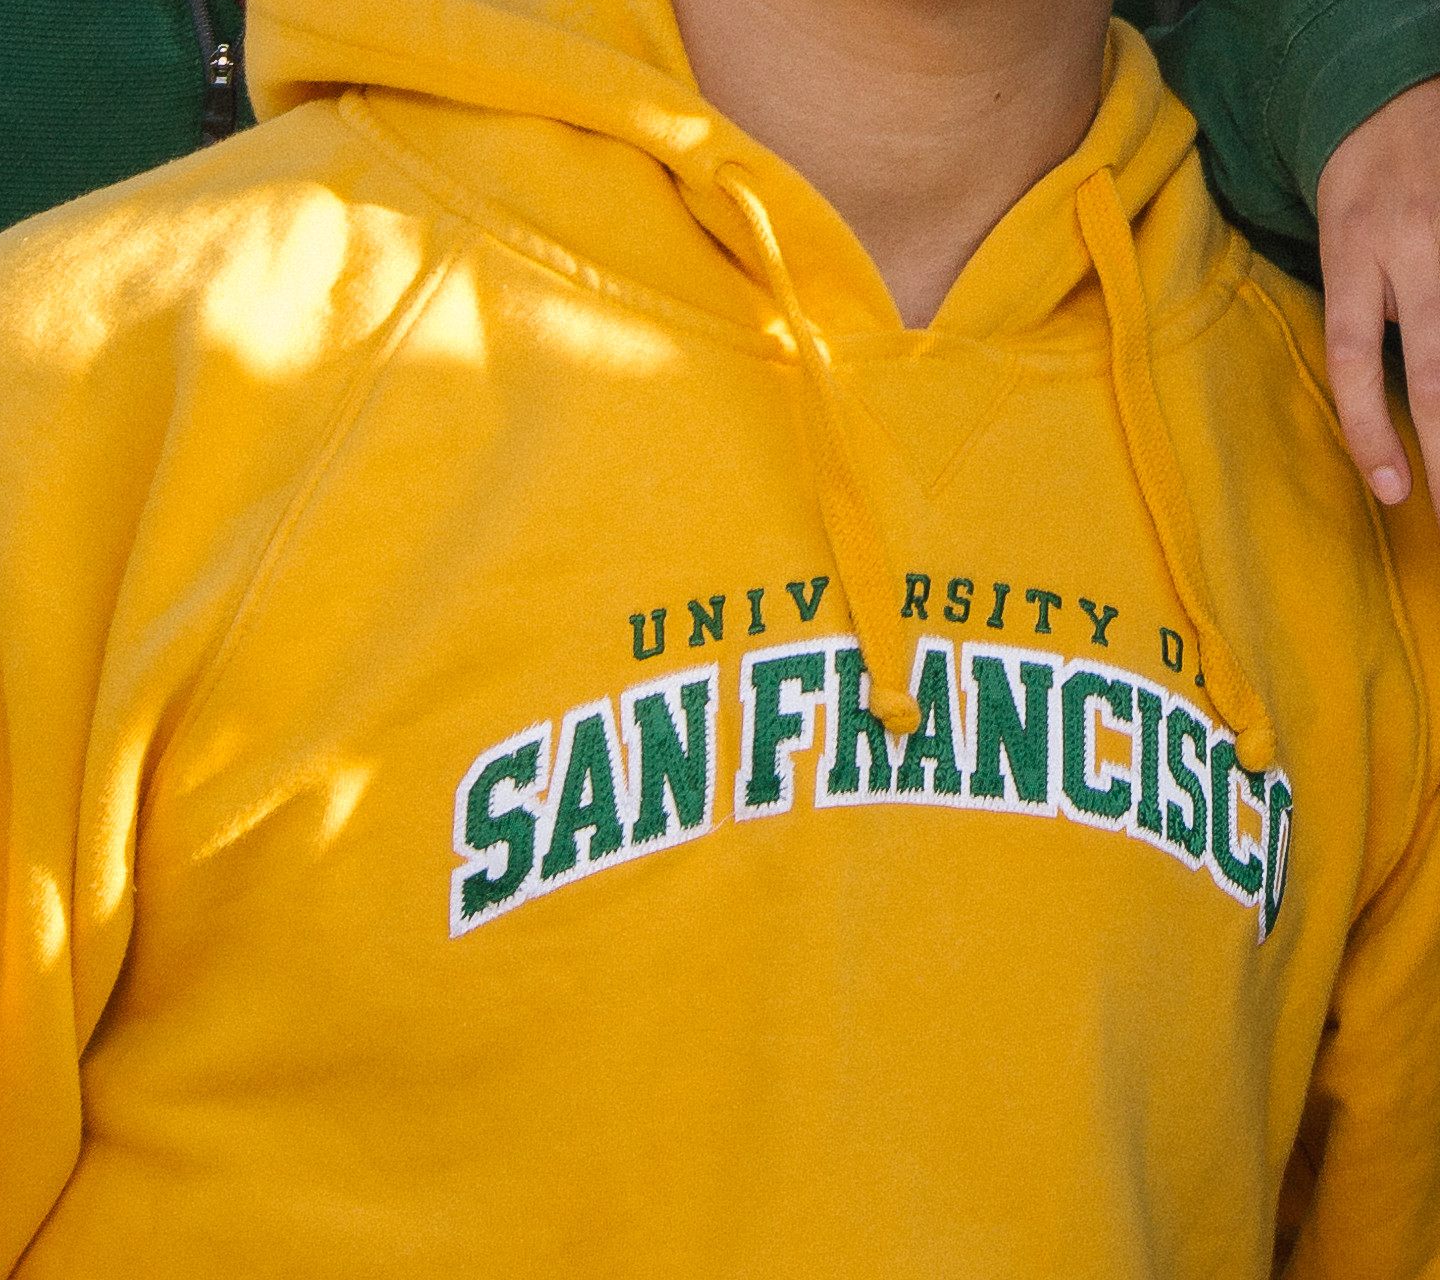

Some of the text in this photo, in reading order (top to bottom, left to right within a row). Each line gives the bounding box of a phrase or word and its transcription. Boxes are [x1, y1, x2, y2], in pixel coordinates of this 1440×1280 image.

[629, 572, 1206, 688] UNIVRSITY O
[449, 661, 720, 939] SAN
